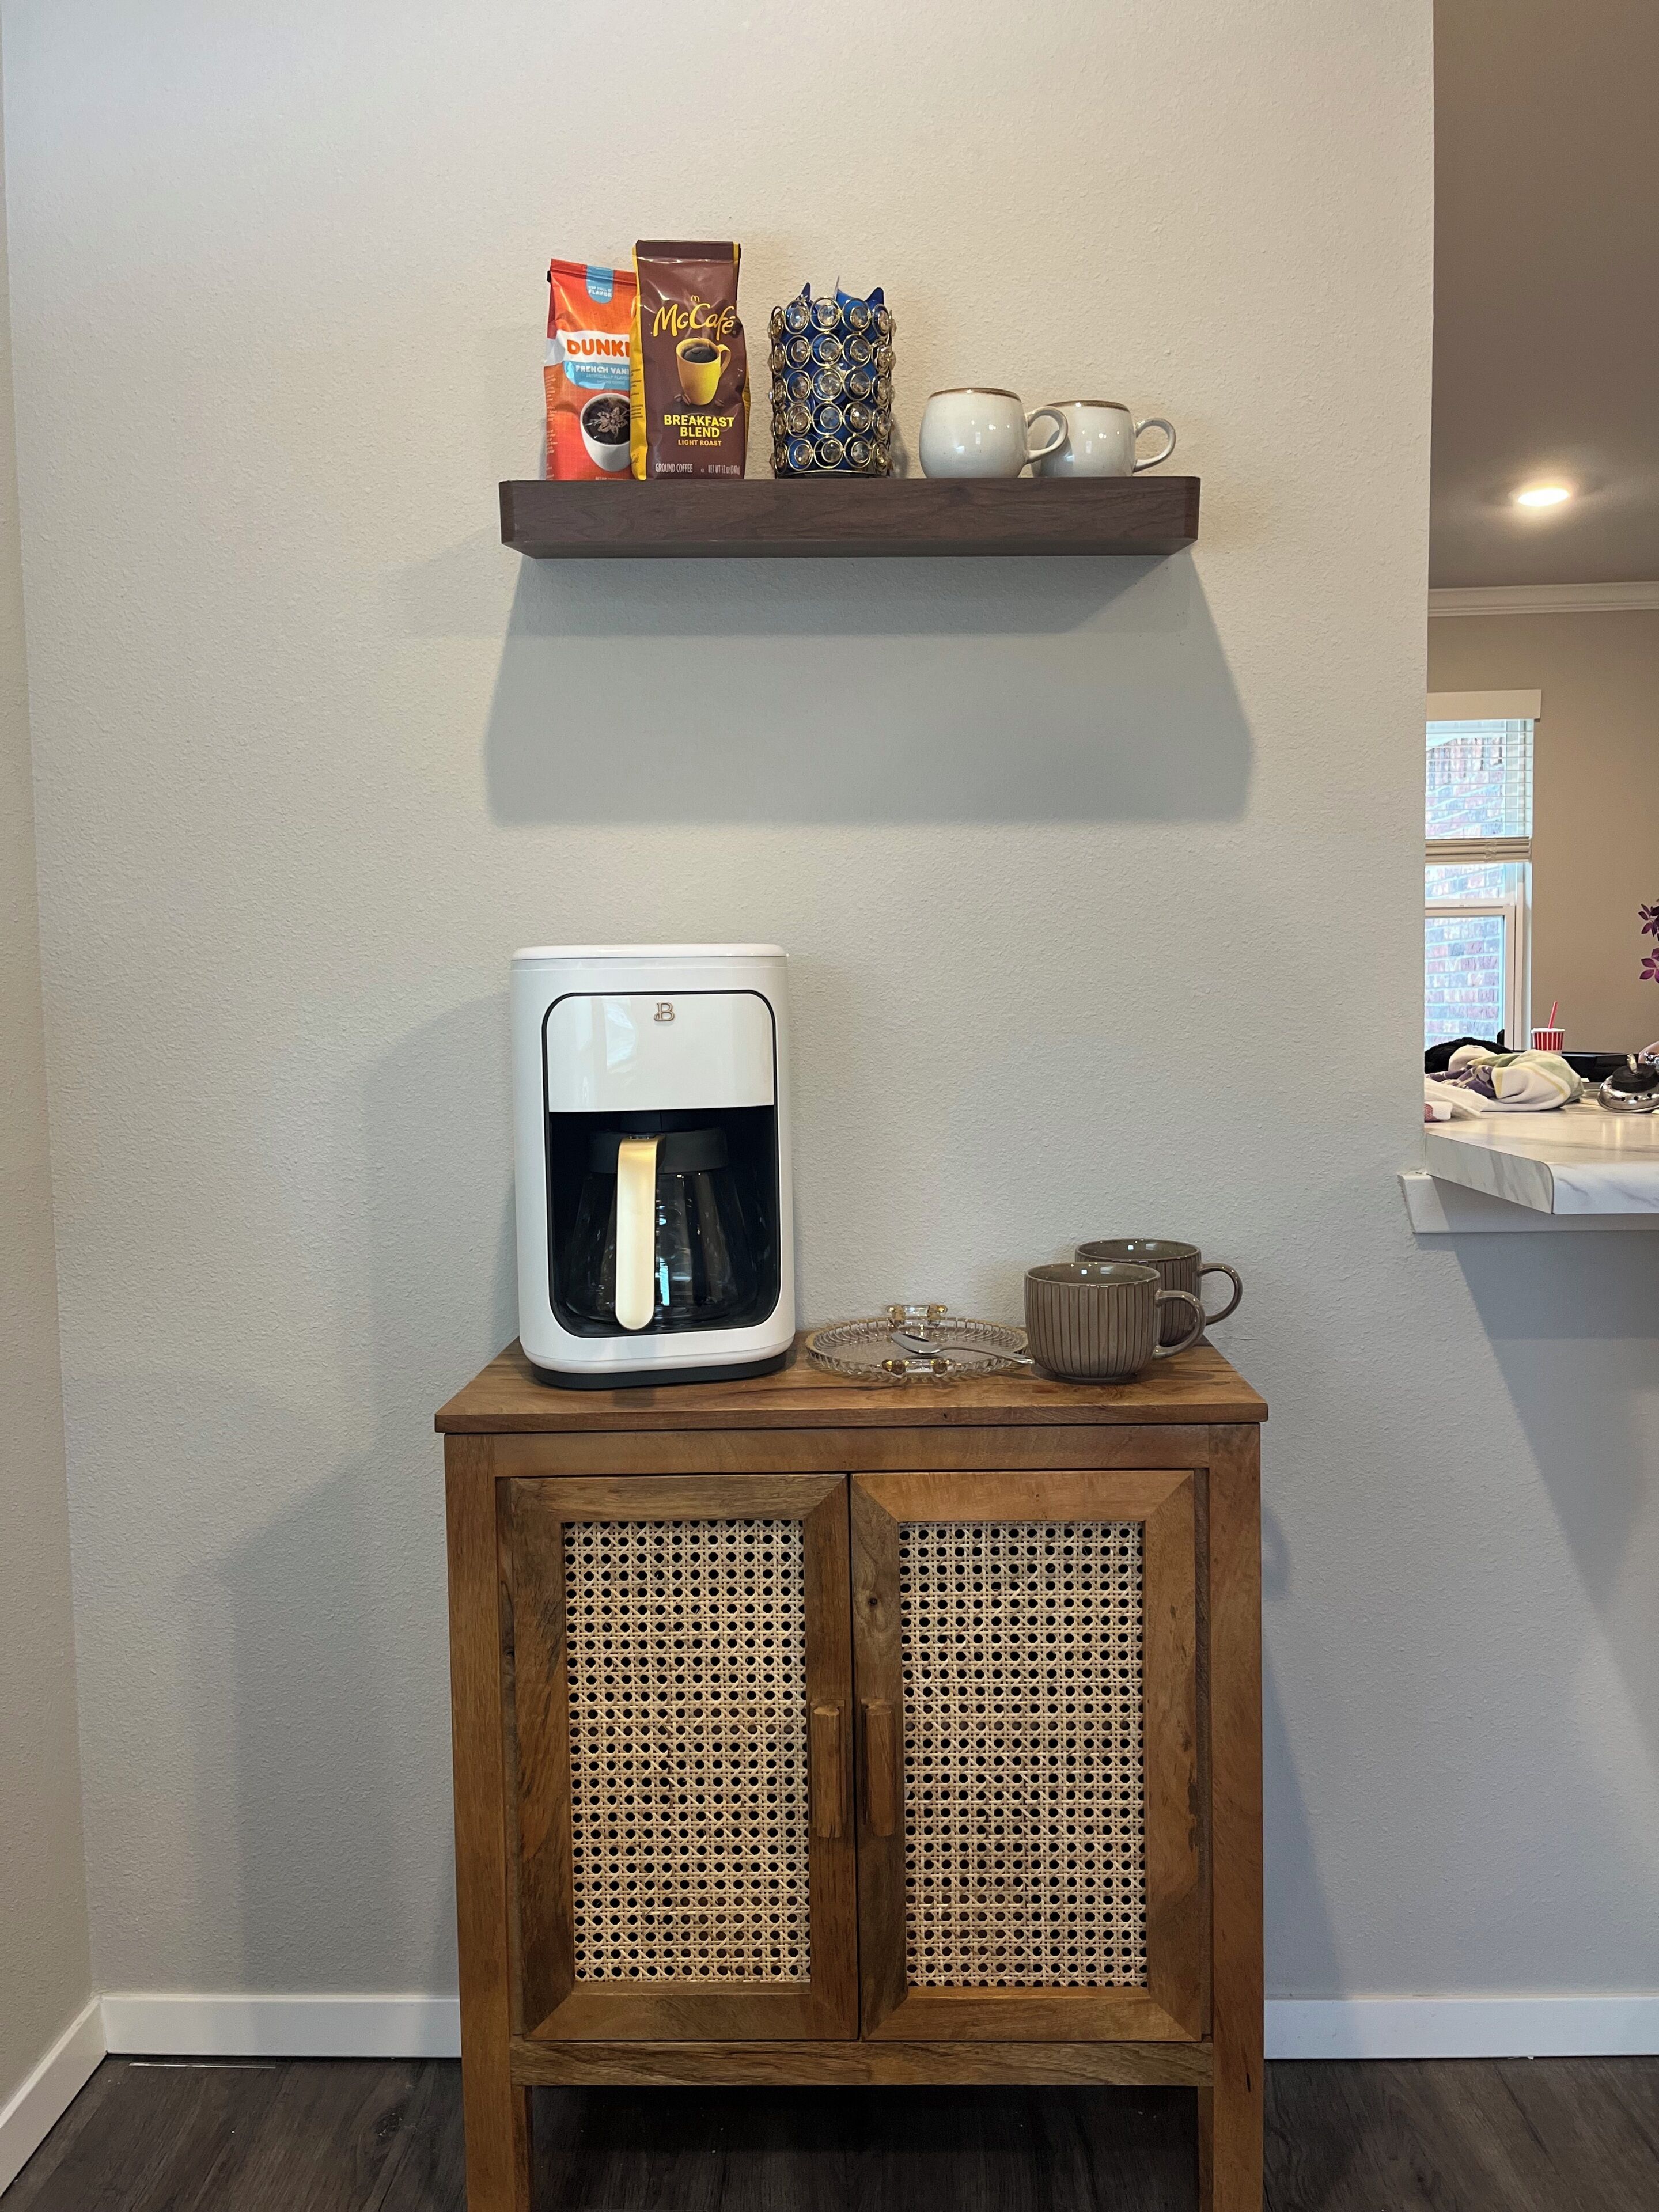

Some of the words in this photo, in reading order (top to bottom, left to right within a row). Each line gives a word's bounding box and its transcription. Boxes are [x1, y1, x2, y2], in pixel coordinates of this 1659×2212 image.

[588, 289, 612, 298] FLAVOR
[653, 303, 736, 341] McCafé
[575, 365, 609, 374] FRENCH
[664, 414, 734, 427] BREAKFAST
[680, 426, 720, 438] BLEND
[655, 463, 675, 473] GROUND
[676, 463, 693, 474] COFFEE
[721, 464, 726, 474] 12
[654, 1002, 675, 1022] B
